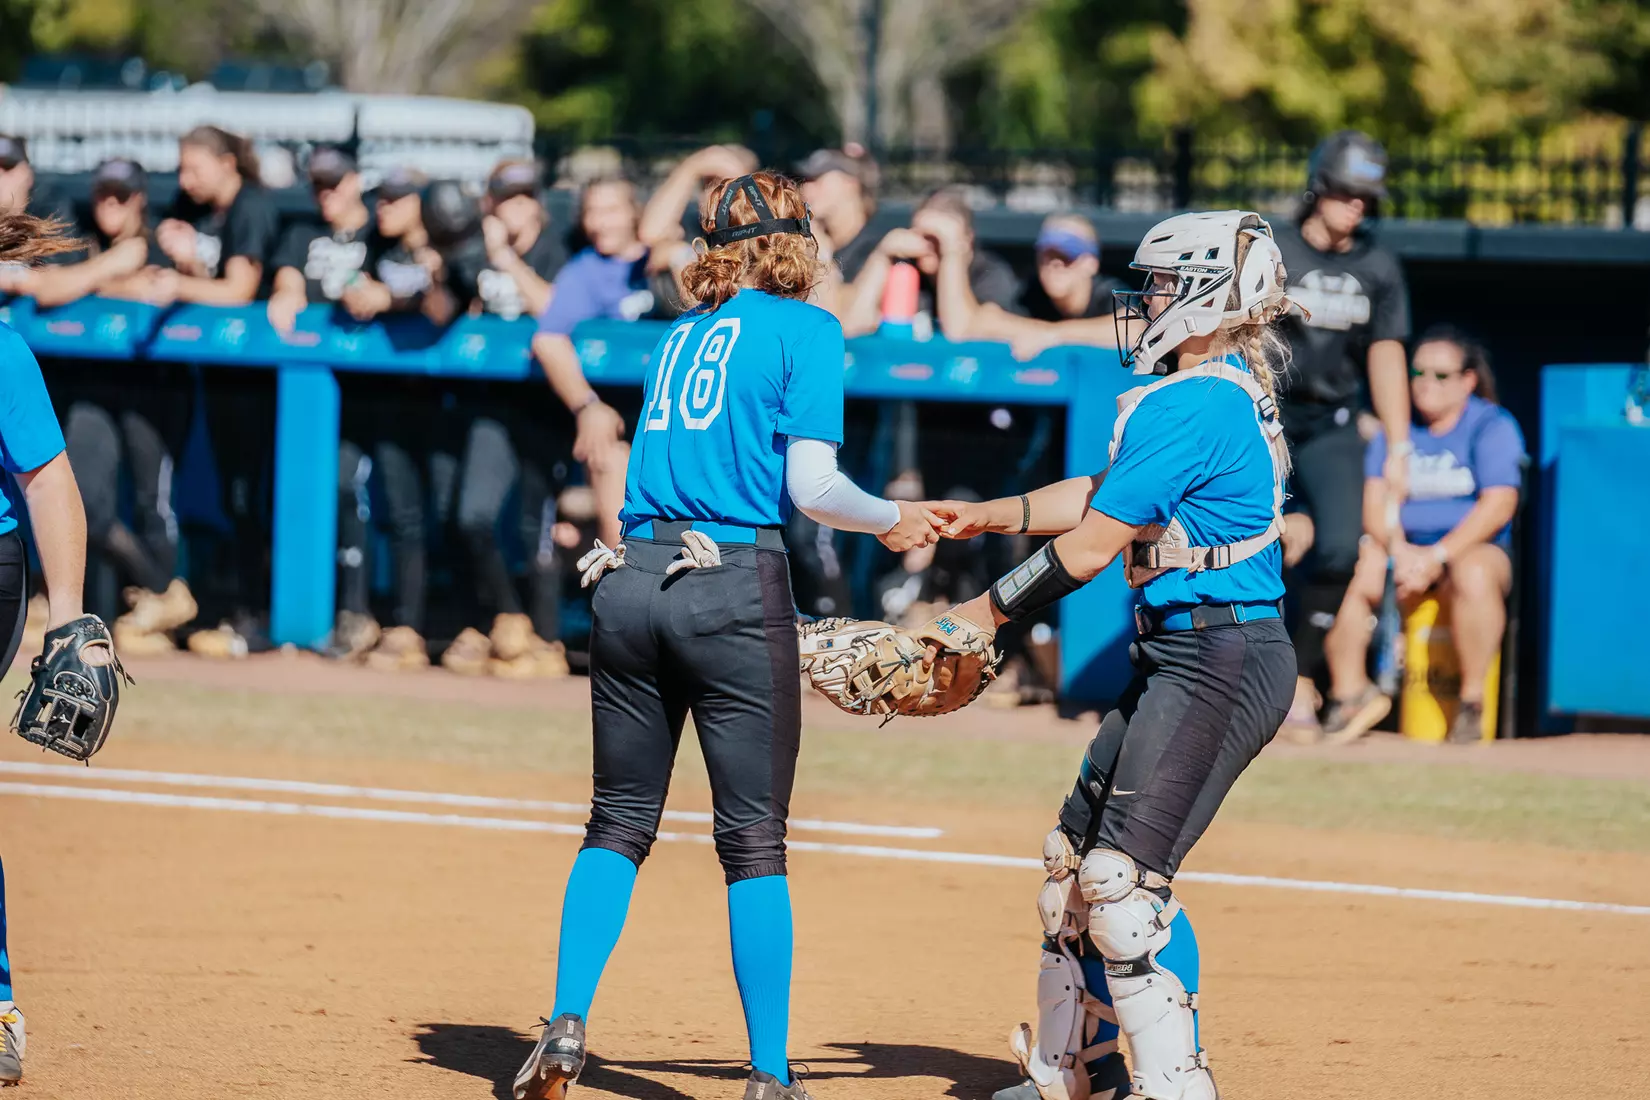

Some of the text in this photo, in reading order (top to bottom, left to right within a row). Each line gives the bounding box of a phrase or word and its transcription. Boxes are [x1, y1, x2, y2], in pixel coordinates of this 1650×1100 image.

[1179, 265, 1208, 273] EASTON
[644, 317, 741, 431] 18
[558, 1037, 581, 1049] NIKE
